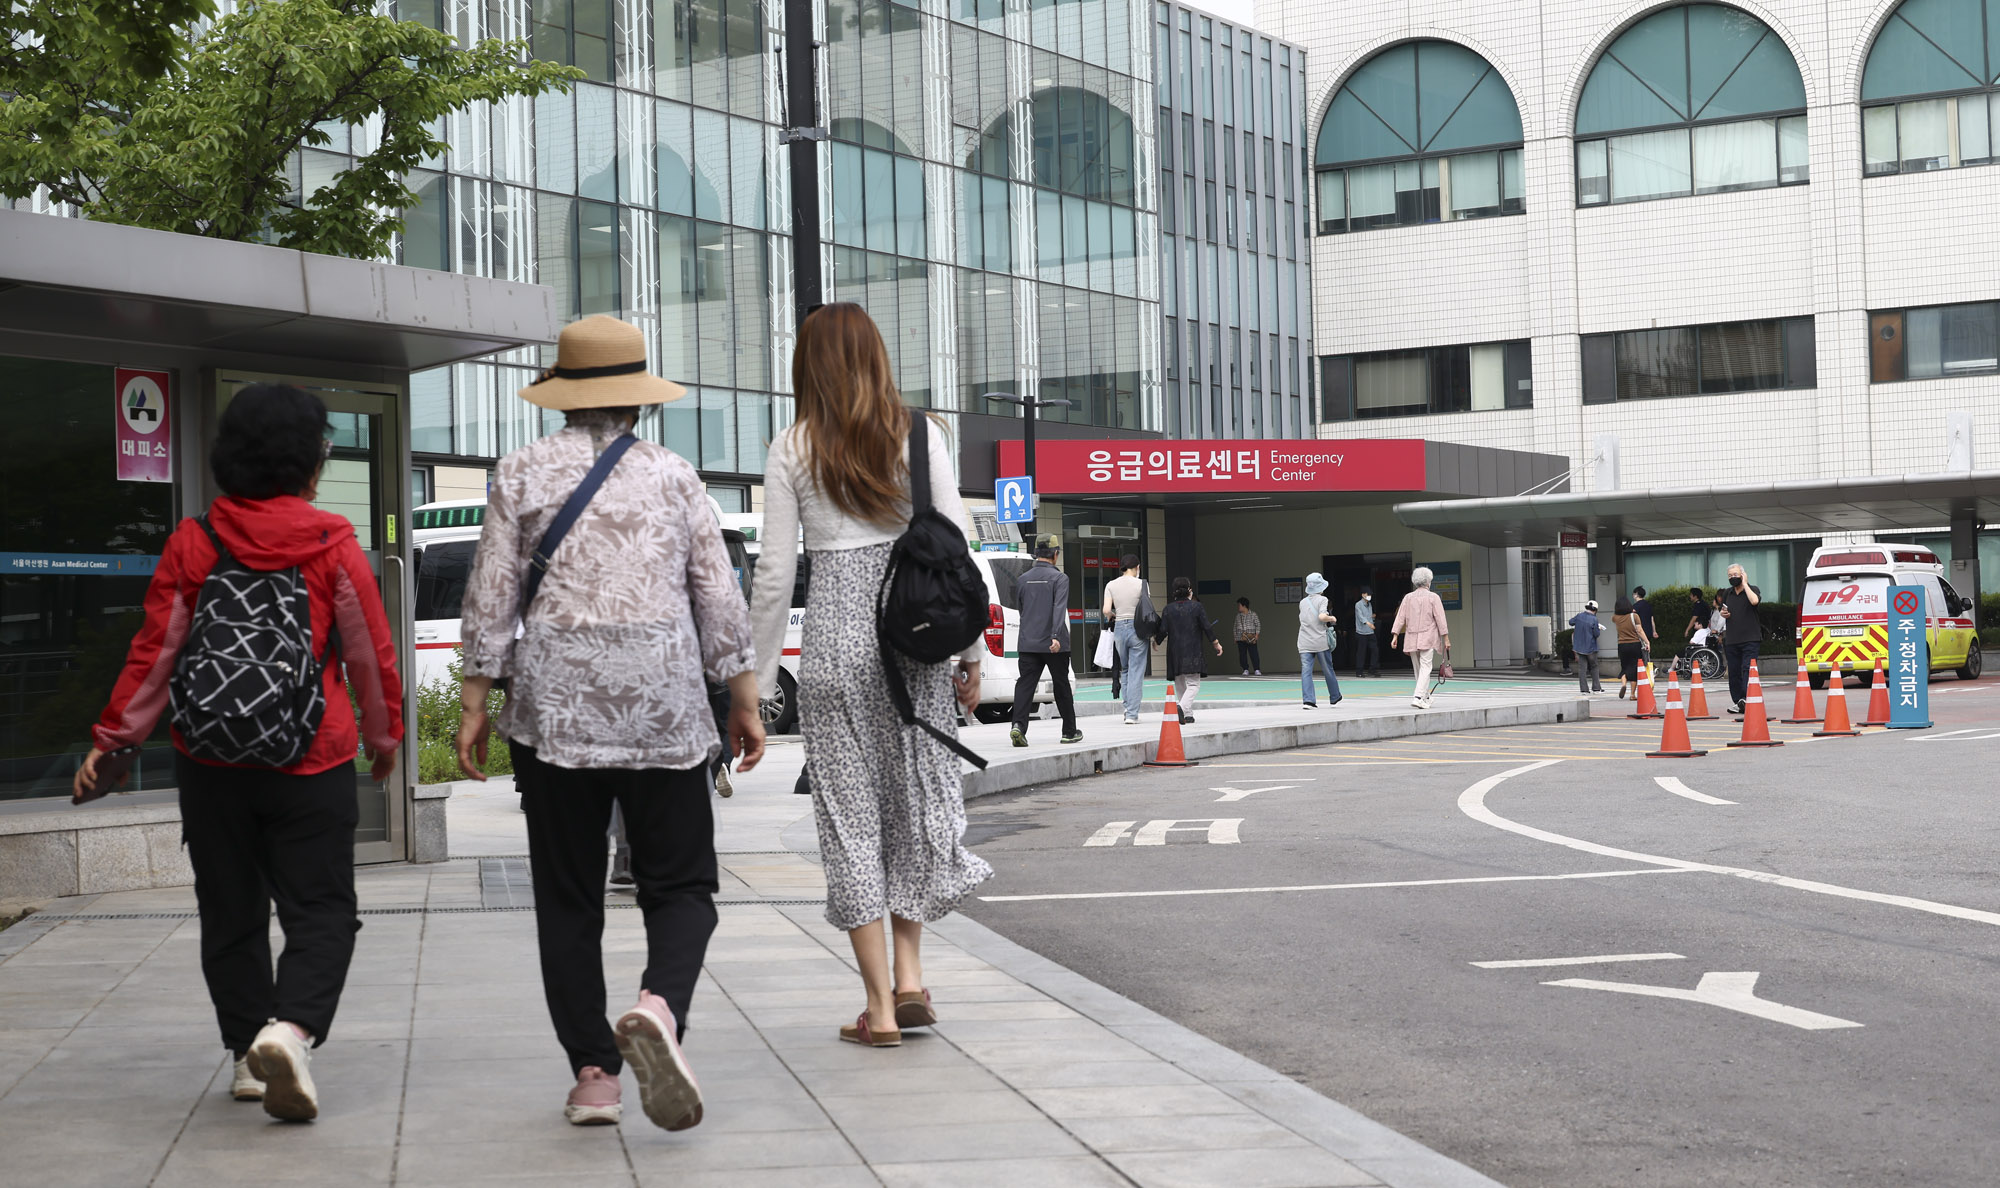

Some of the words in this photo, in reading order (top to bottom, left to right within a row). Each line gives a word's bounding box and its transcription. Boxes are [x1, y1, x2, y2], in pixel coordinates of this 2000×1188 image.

[122, 440, 167, 457] 대피소
[1087, 450, 1260, 481] 응급의료센터
[1271, 450, 1344, 467] Emergency
[1271, 468, 1316, 481] Center
[1004, 509, 1026, 520] 출구
[52, 560, 66, 568] Asan
[90, 561, 108, 569] Center
[1816, 584, 1860, 606] 119
[1856, 594, 1879, 604] 구급대
